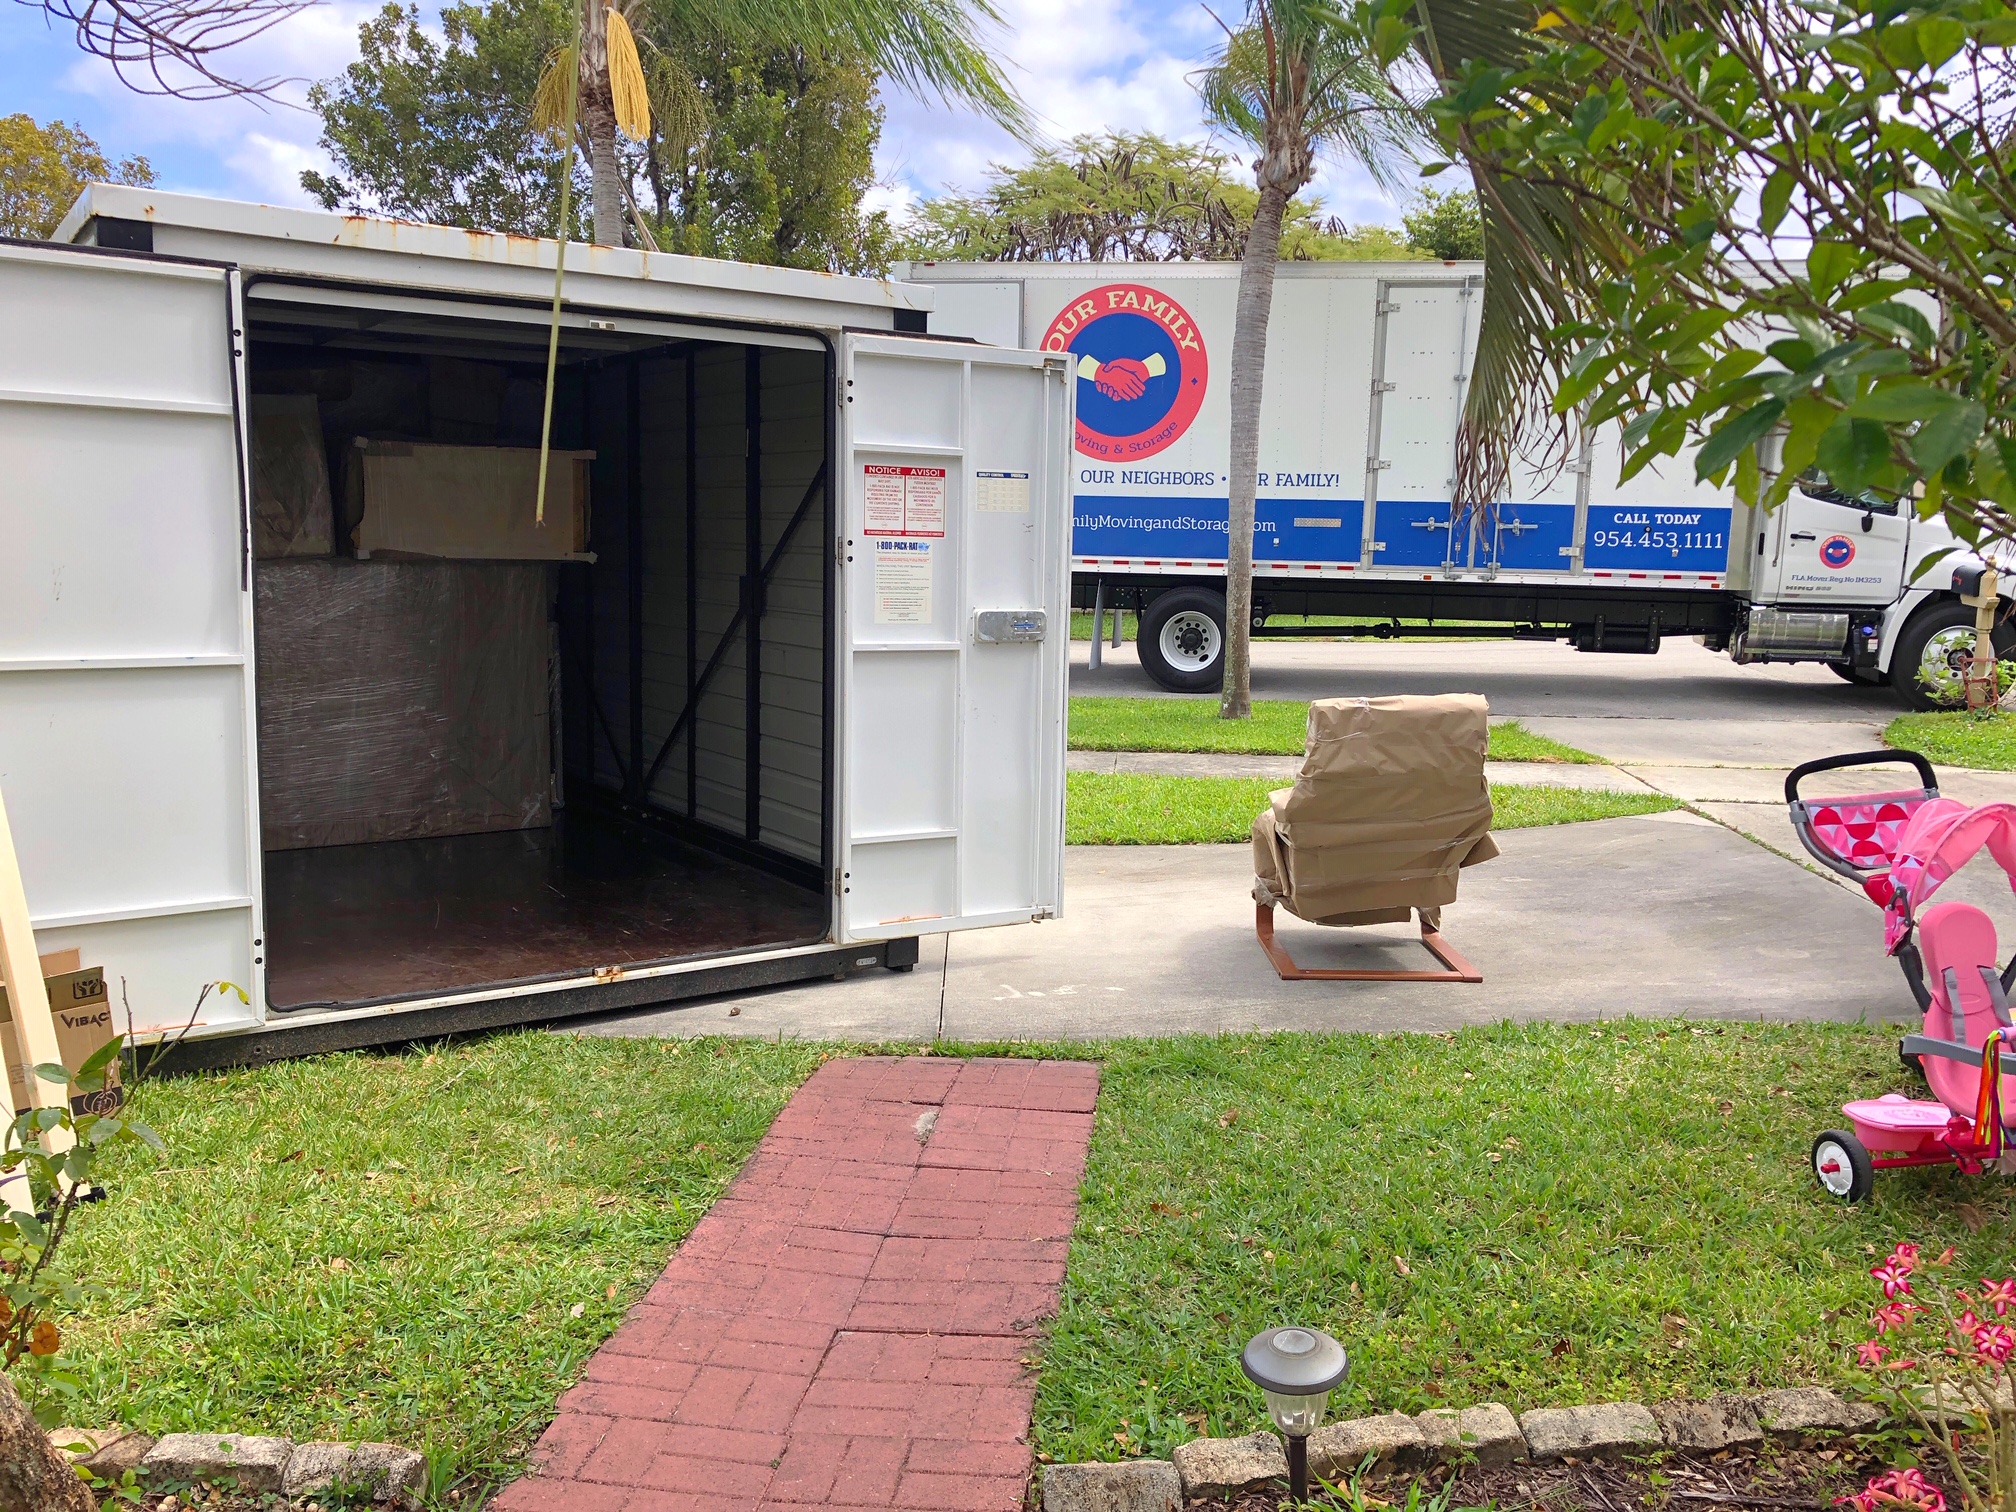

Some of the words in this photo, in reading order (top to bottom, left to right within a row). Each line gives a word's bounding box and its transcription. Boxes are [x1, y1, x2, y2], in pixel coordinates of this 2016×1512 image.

[1046, 299, 1097, 352] OUR
[1106, 290, 1200, 352] FAMILY
[1075, 431, 1108, 454] oving
[1114, 444, 1123, 453] &
[1129, 422, 1178, 452] Storage
[868, 466, 902, 475] NOTICE
[910, 468, 940, 477] AVISO!
[1080, 469, 1115, 483] OUR
[1121, 470, 1215, 485] NEIGHBORS
[1275, 473, 1340, 487] FAMILY!
[1613, 513, 1650, 524] CALL
[1654, 514, 1702, 525] TODAY
[876, 541, 919, 551] 1-800-PACK-RAT
[1593, 530, 1723, 549] 954.453.1111
[60, 1012, 109, 1029] VIBAC
